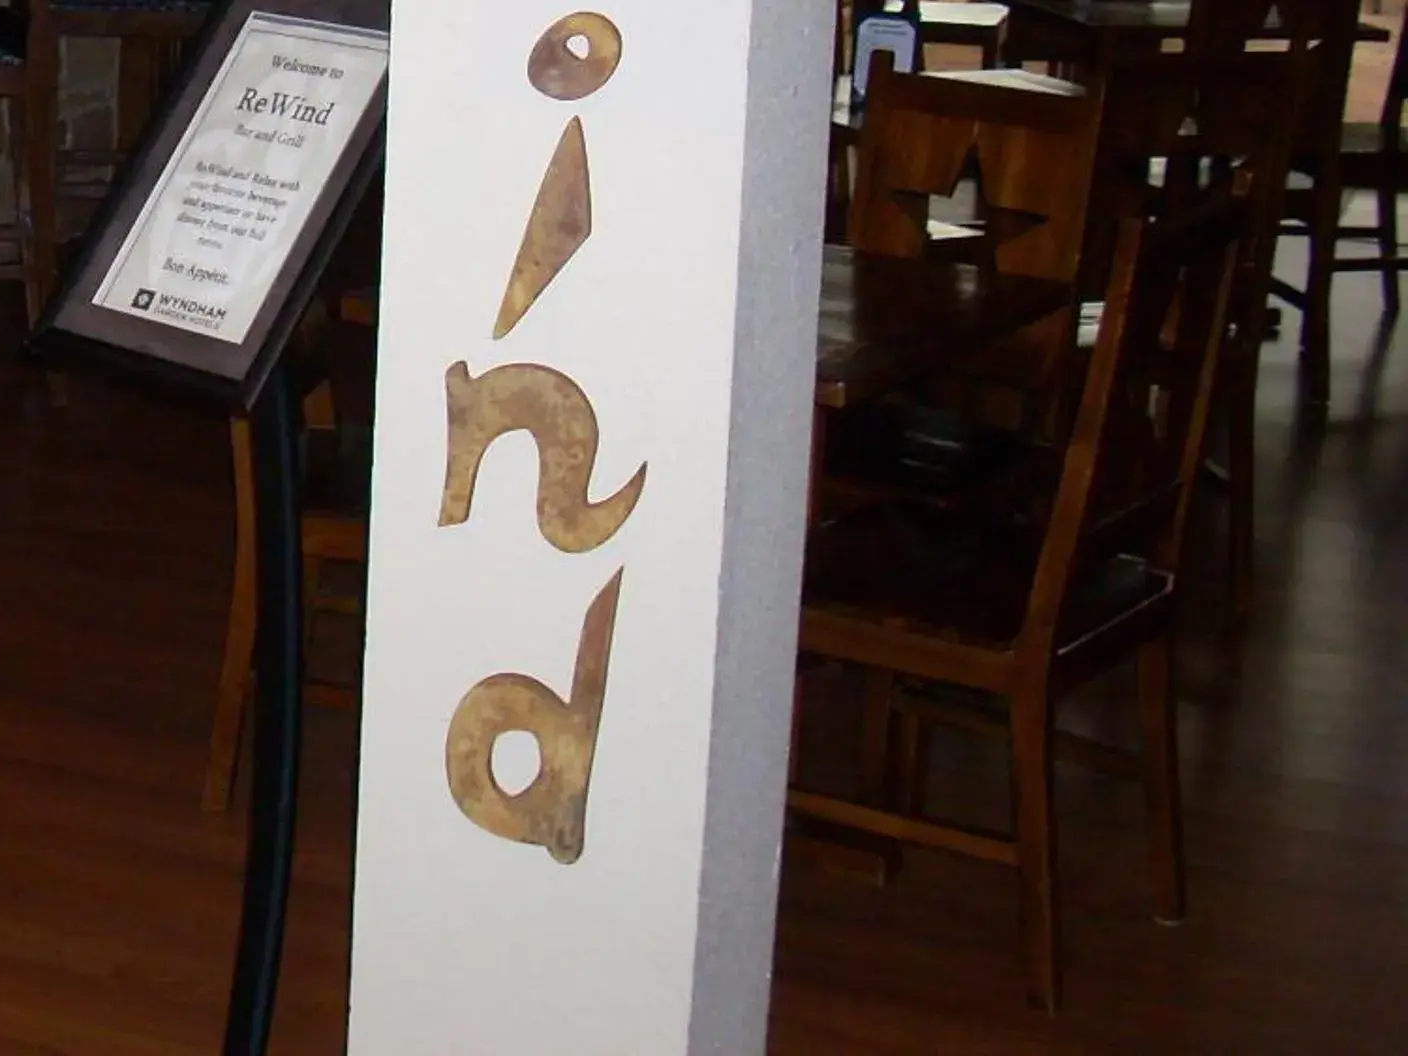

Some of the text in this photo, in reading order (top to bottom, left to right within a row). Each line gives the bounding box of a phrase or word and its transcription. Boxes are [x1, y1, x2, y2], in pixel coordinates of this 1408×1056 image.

[272, 54, 344, 80] Welcome to
[235, 87, 335, 126] ReWind
[255, 129, 276, 143] and
[277, 132, 305, 148] Grill
[162, 257, 185, 274] Bon
[159, 293, 227, 320] WYNDHAM
